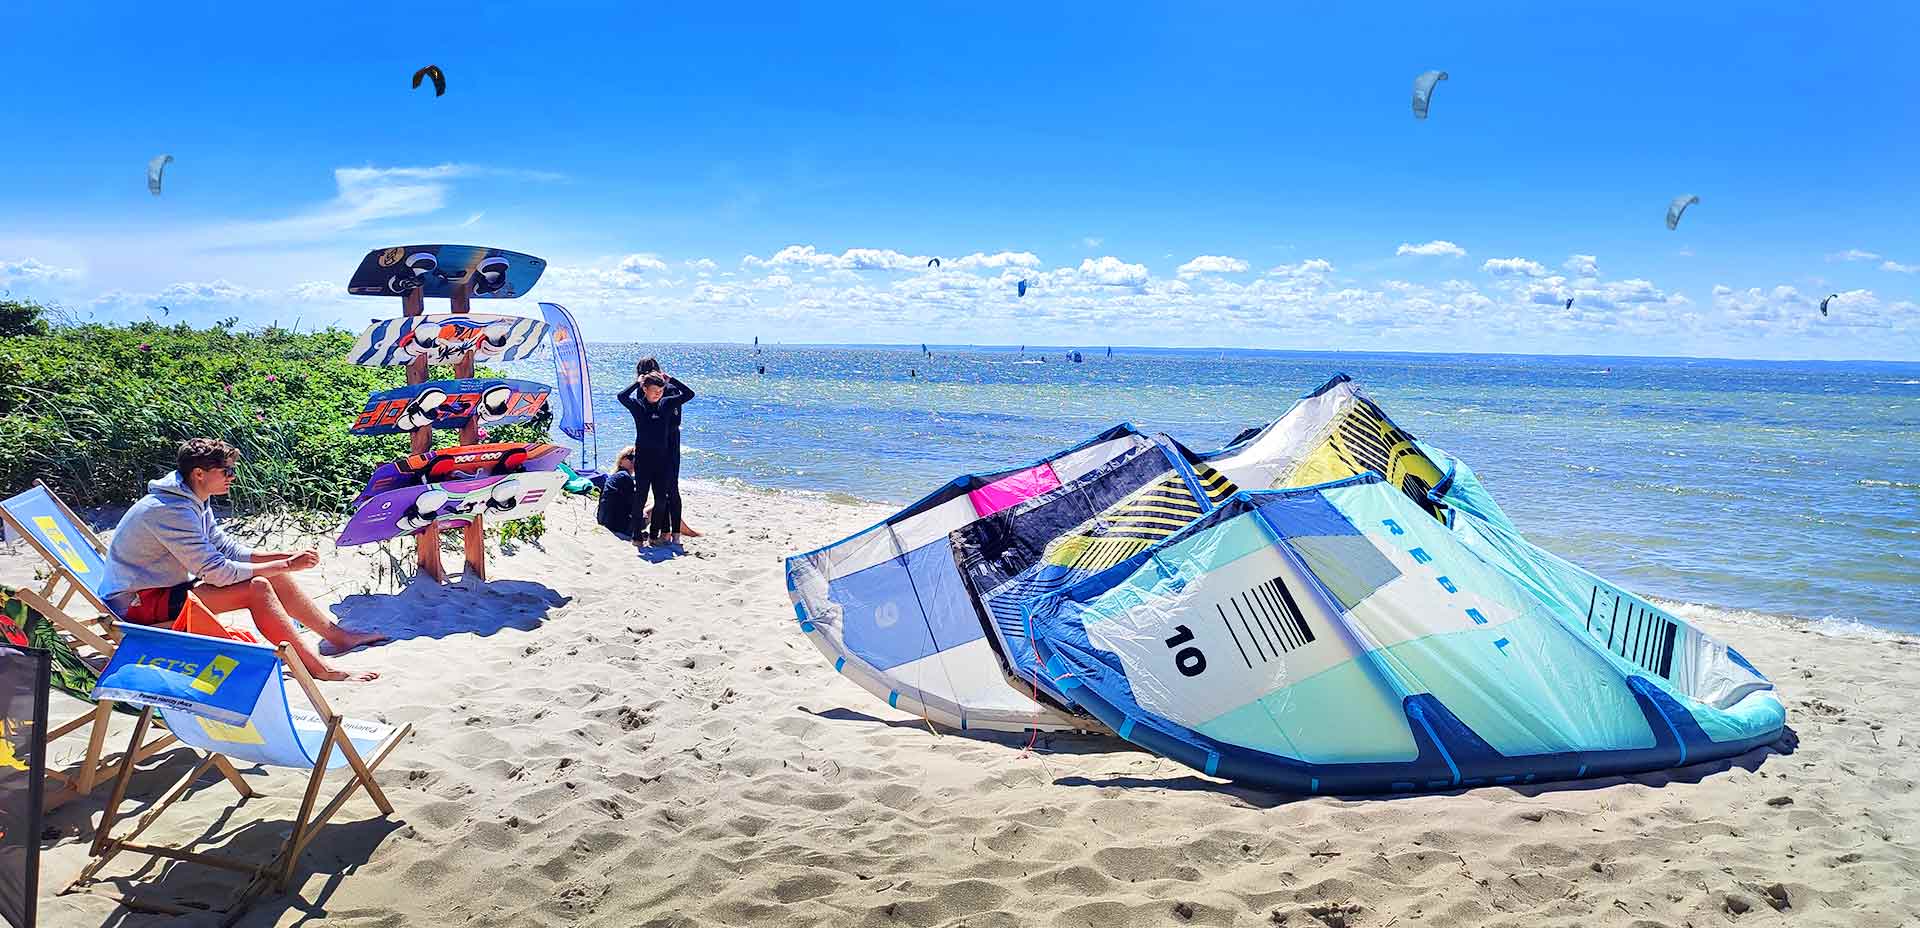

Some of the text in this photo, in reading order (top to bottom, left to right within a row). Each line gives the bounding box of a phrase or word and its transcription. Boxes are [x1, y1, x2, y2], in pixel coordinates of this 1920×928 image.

[1382, 518, 1510, 656] REBEL
[136, 655, 199, 676] LET'S
[1165, 624, 1207, 677] 10
